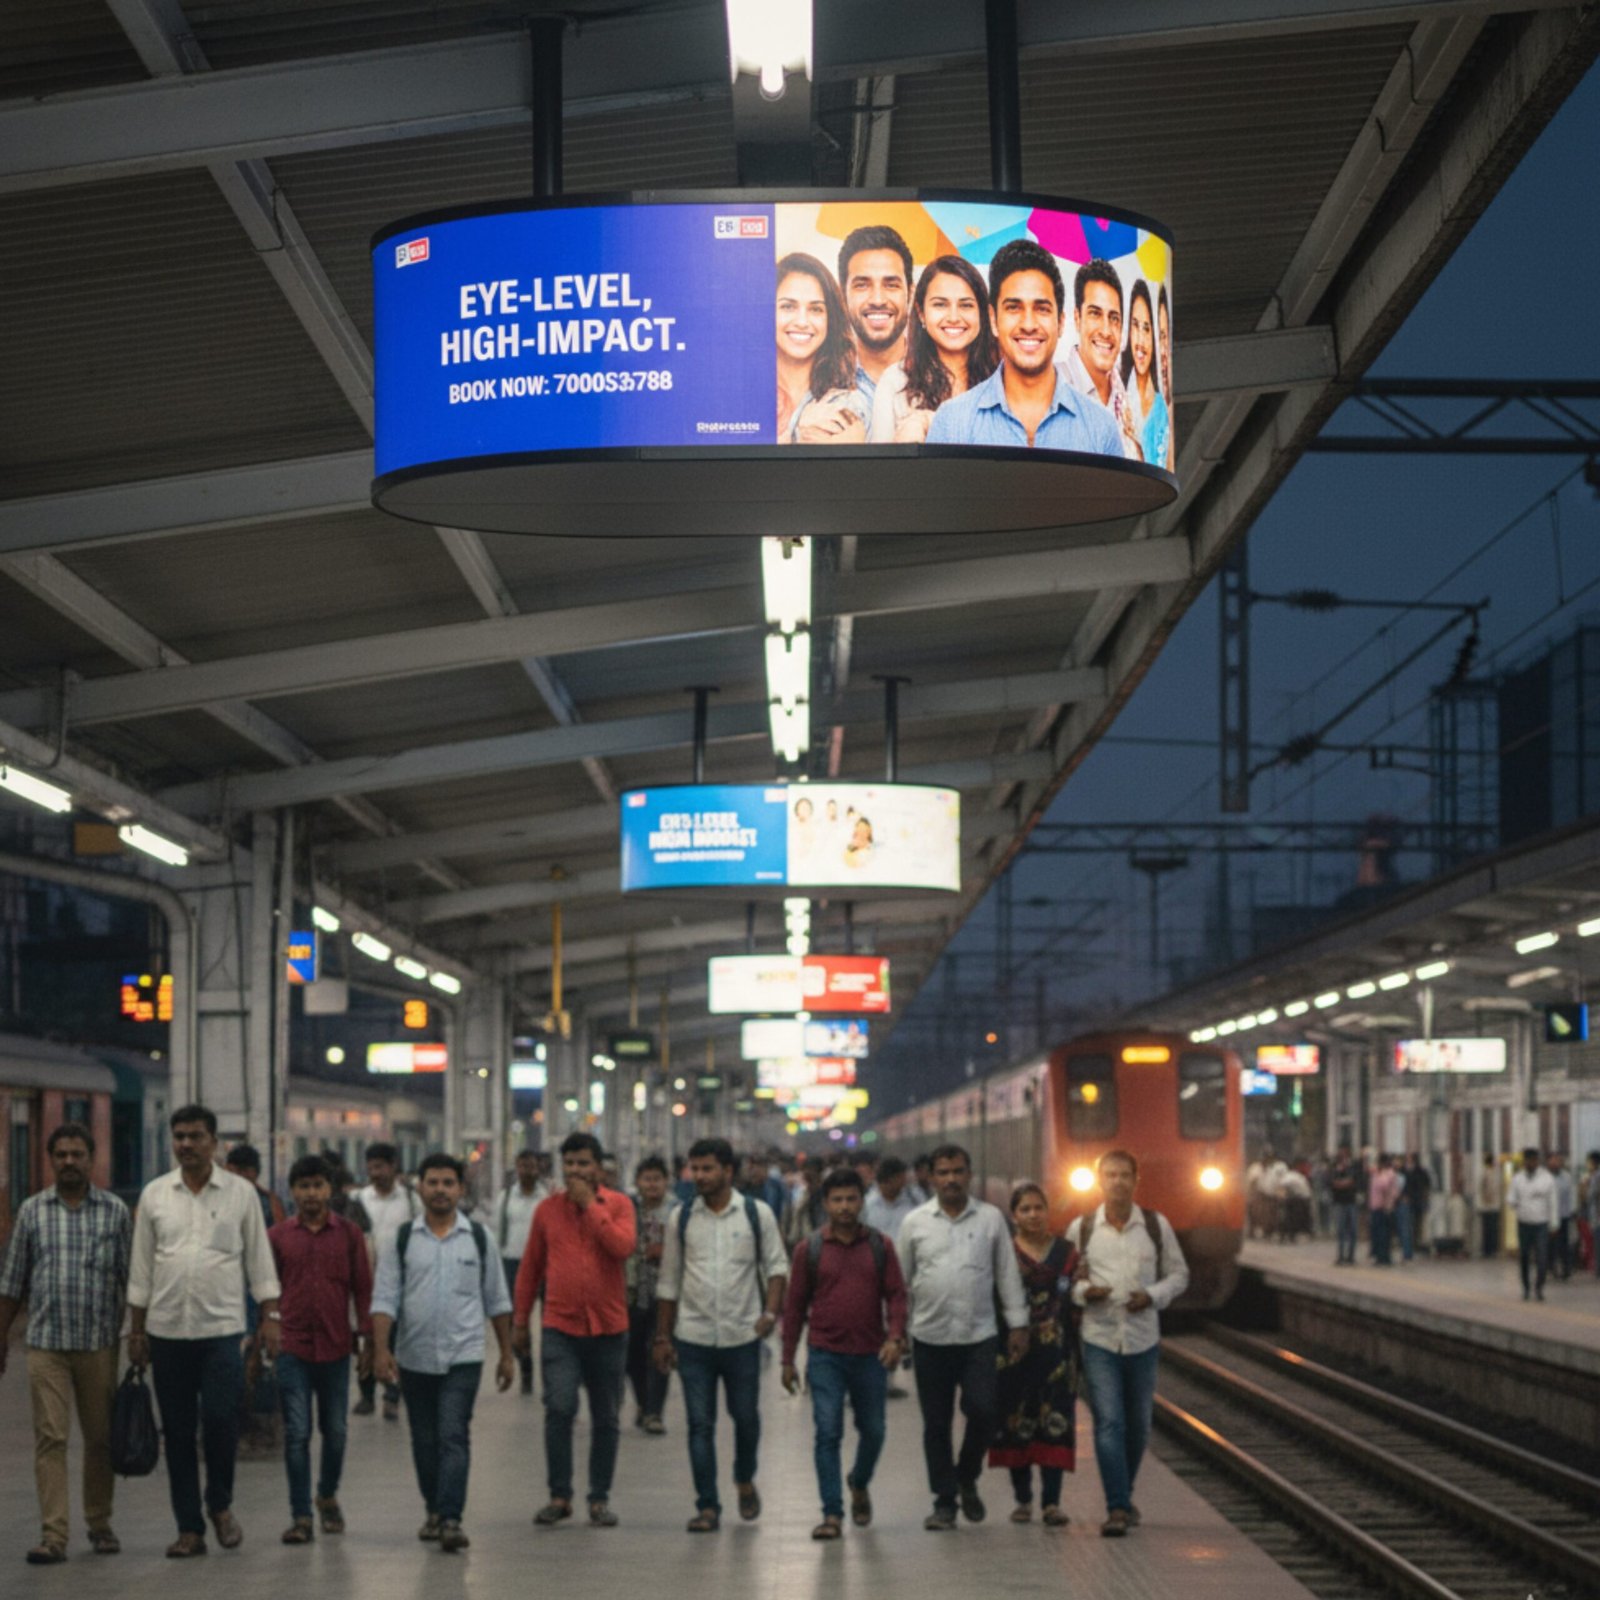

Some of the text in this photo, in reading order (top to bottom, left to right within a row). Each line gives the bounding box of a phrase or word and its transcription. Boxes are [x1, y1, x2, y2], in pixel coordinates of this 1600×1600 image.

[461, 274, 651, 318] EYE-LEVEL,
[442, 318, 685, 365] HIGH-IMPACT.
[450, 380, 495, 403] BOOK
[502, 376, 549, 397] NOW:
